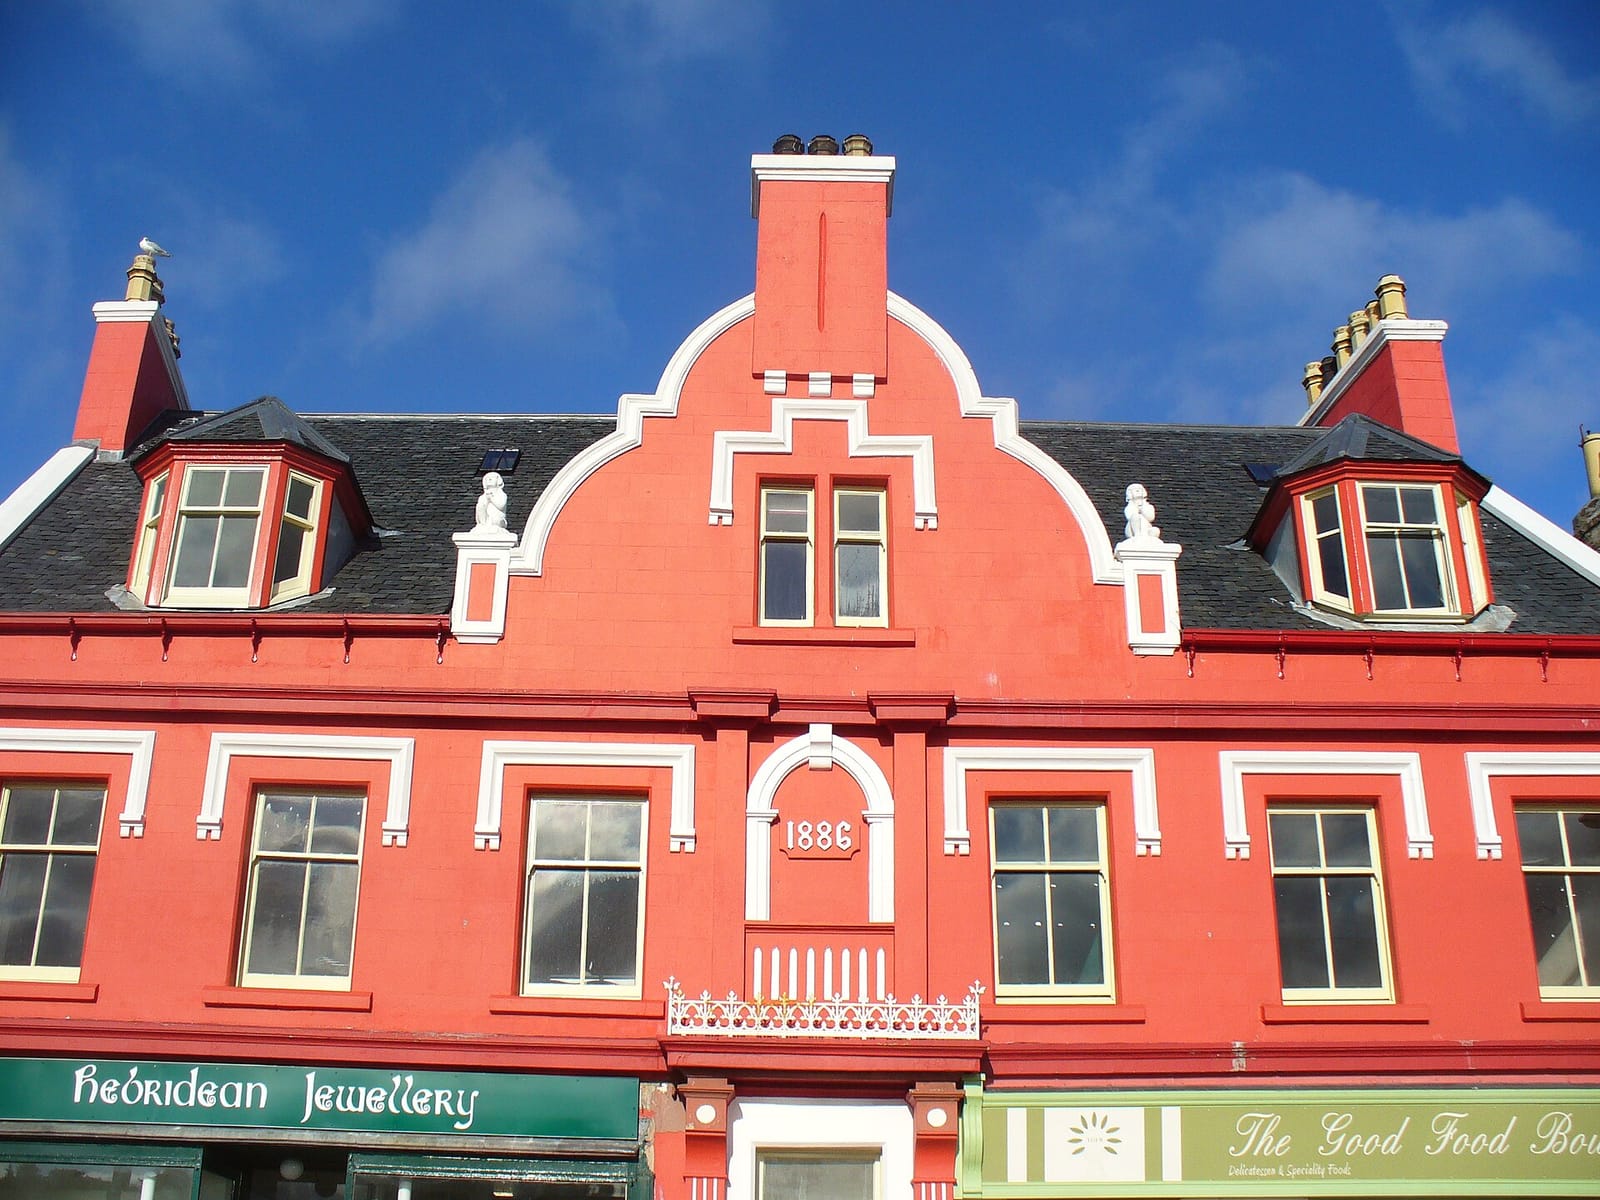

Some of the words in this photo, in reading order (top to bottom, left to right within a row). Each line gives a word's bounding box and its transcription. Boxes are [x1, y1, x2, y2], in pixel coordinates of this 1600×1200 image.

[786, 820, 852, 851] 1886
[1228, 1112, 1292, 1157] The
[1318, 1112, 1411, 1156] Good
[1425, 1112, 1517, 1155] Food
[1228, 1163, 1276, 1176] Delicatessen
[1278, 1164, 1284, 1176] &
[1286, 1163, 1325, 1179] Speciality
[1327, 1161, 1351, 1175] Foods
